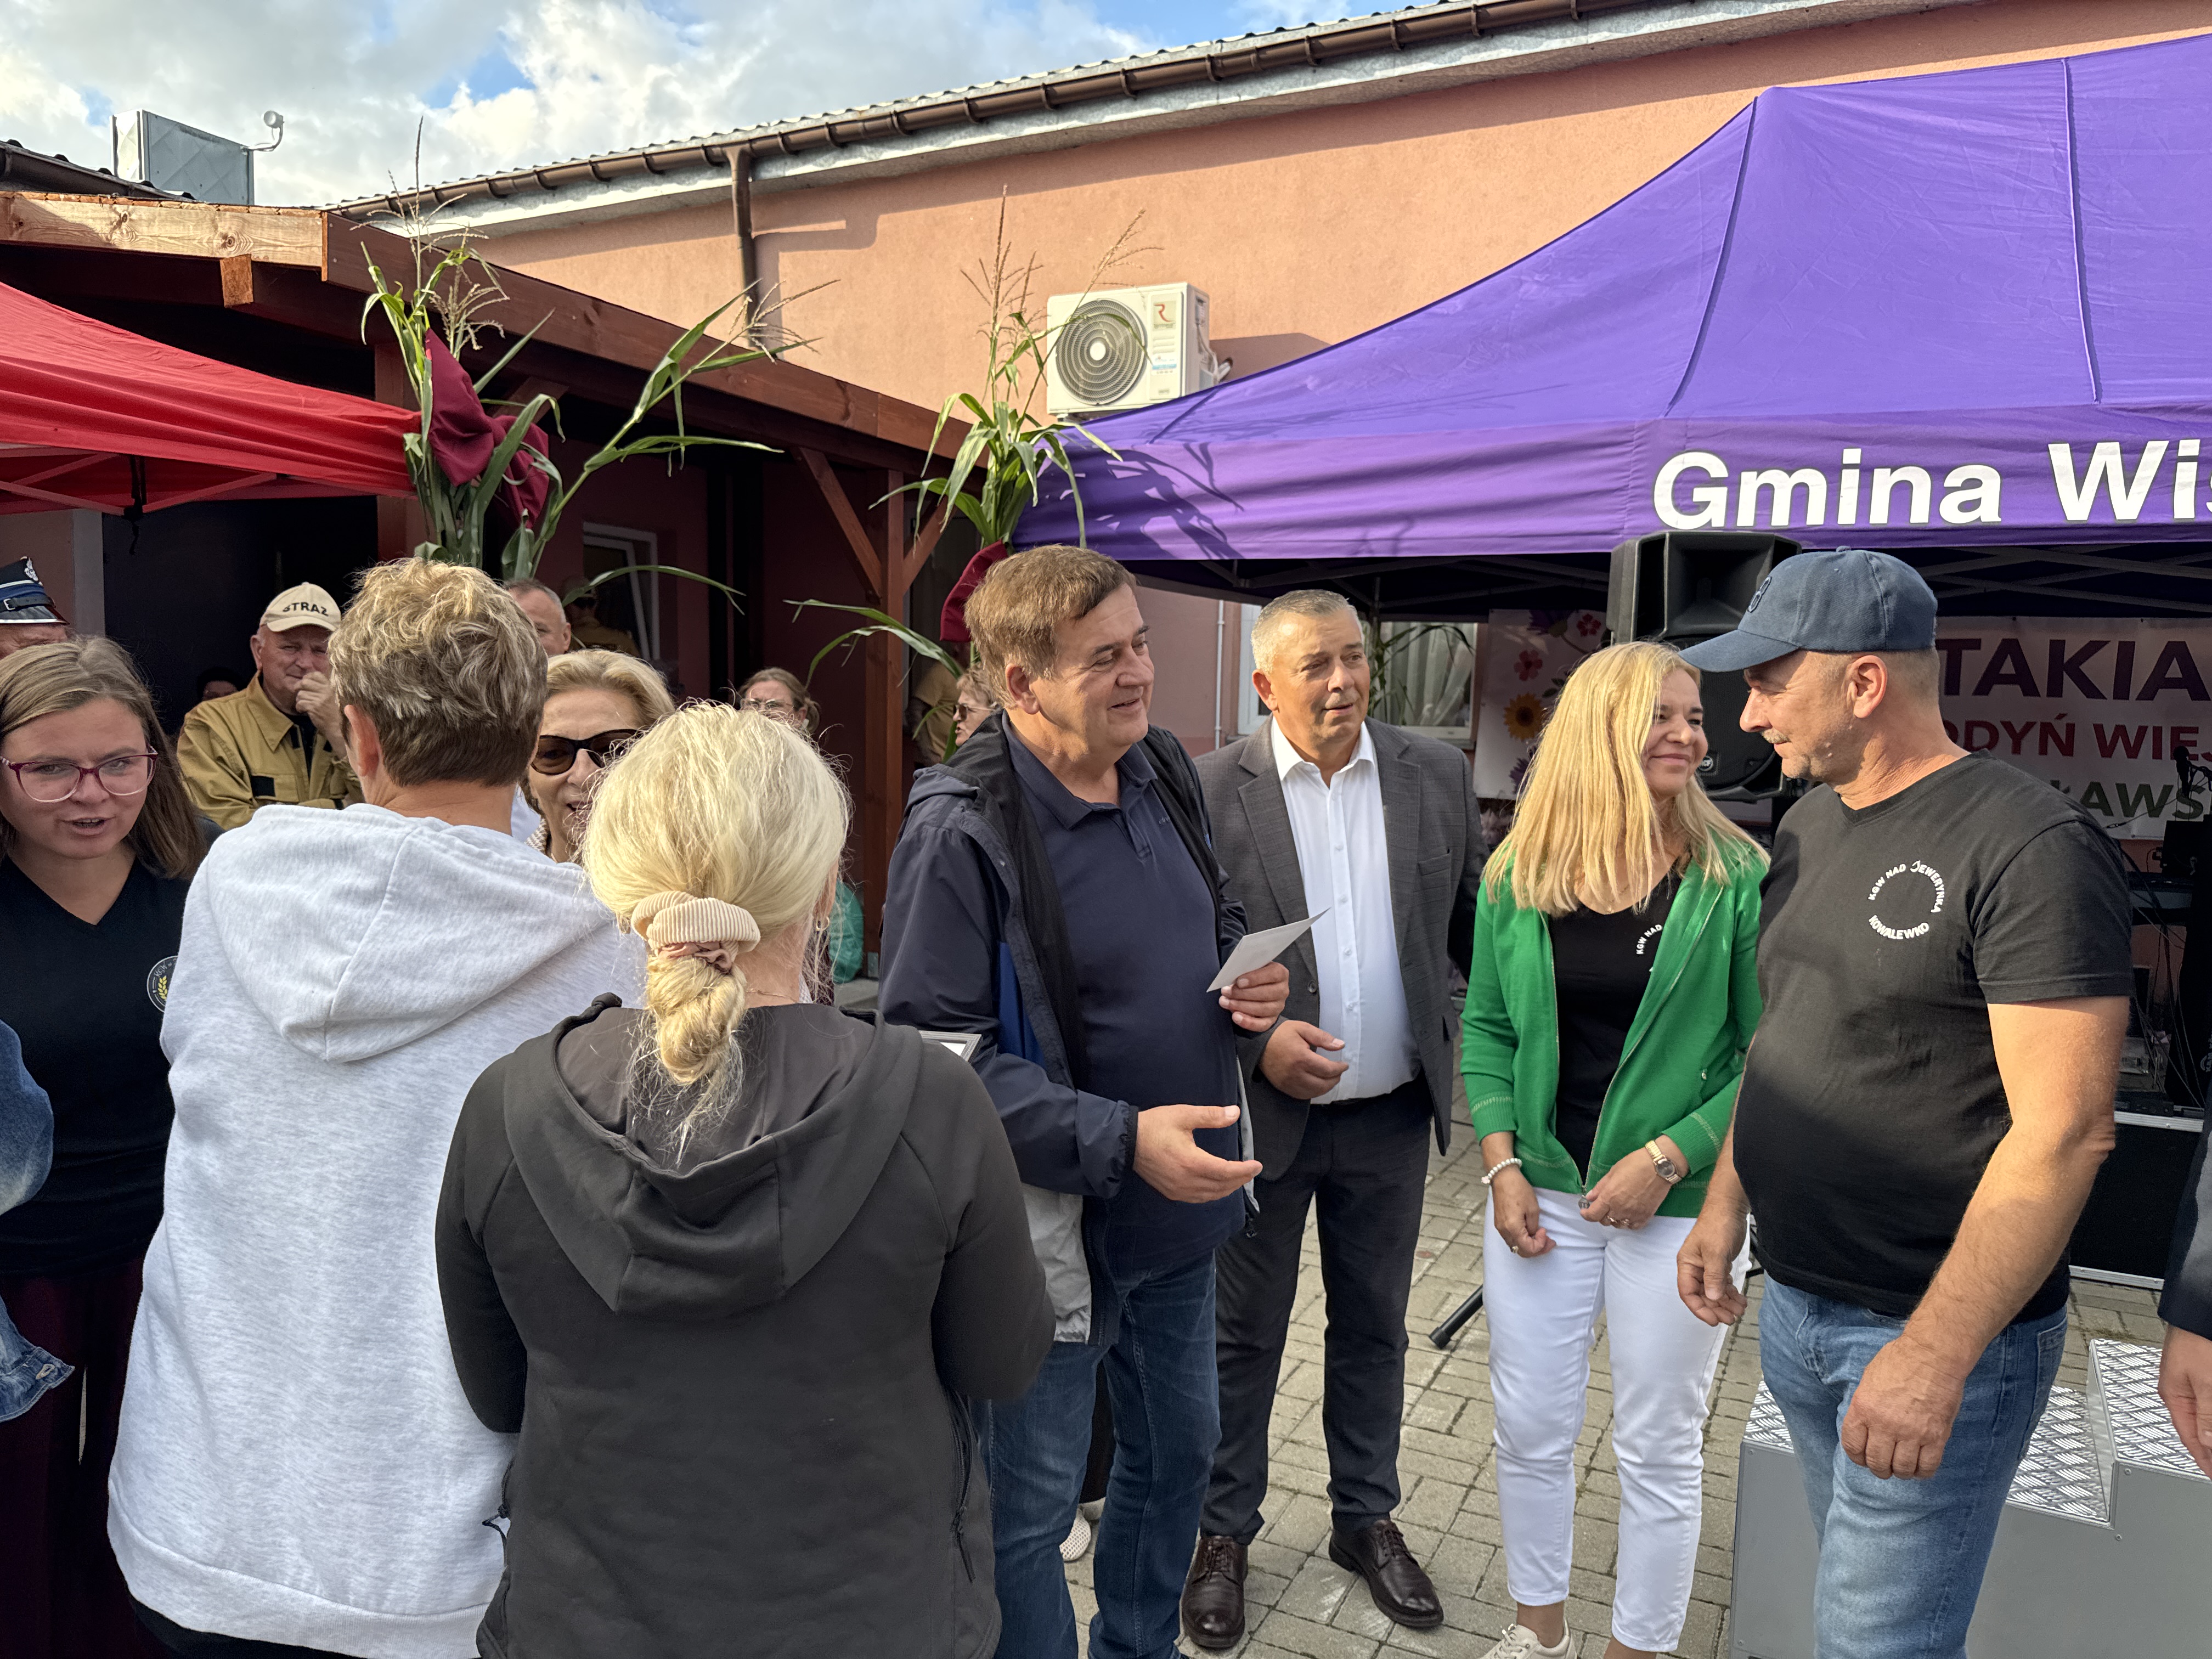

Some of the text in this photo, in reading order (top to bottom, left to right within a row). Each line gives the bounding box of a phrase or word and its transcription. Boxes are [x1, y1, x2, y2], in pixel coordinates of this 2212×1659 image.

[1652, 439, 2212, 530] Gmina Wi
[1935, 638, 2211, 702] TAKIA
[2092, 723, 2212, 763] WIE
[1867, 876, 1886, 900] KGW
[1885, 864, 1906, 879] NAD
[1636, 924, 1663, 955] KGW NAD
[1868, 915, 1930, 940] KOWALEWKO
